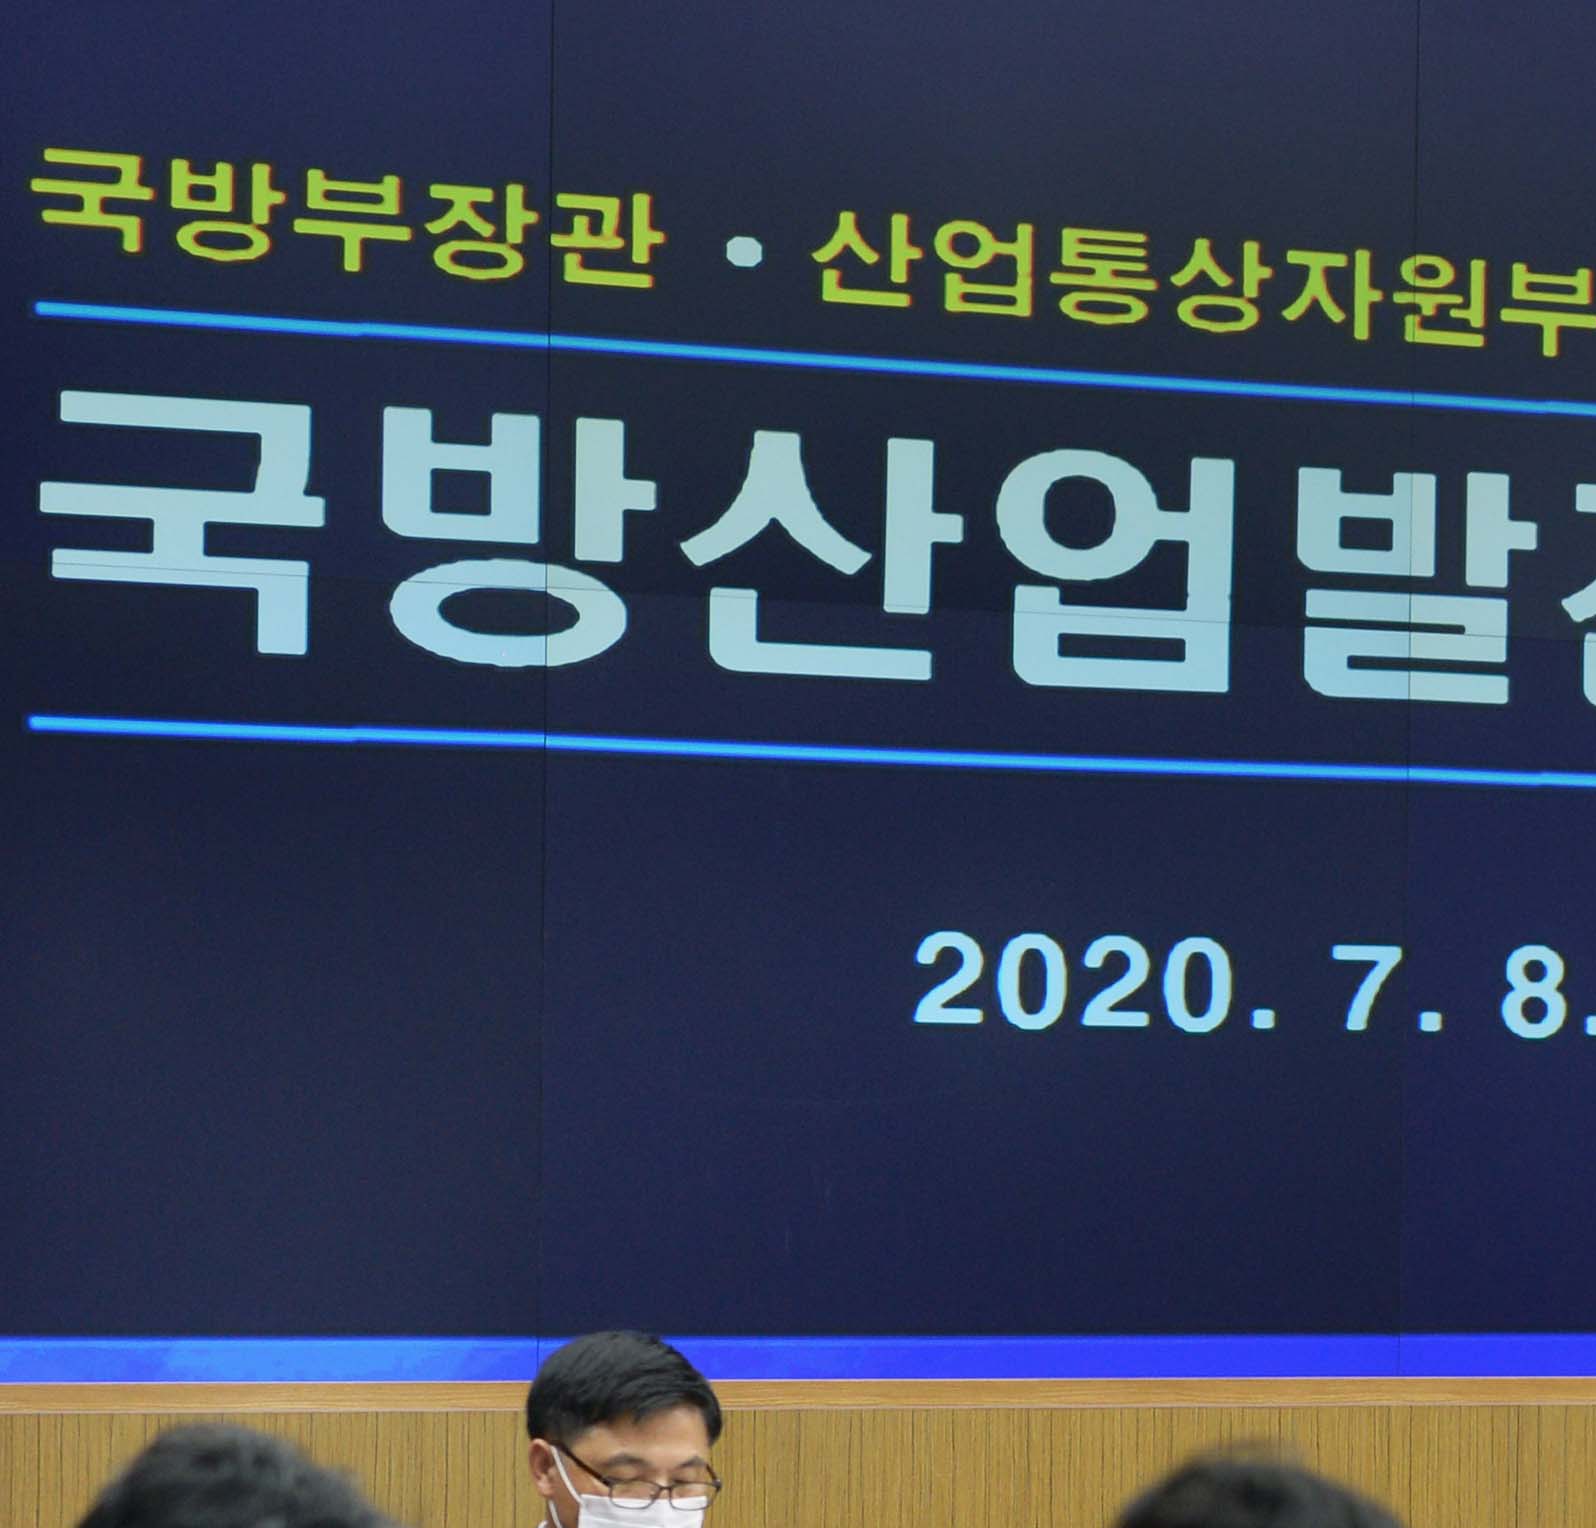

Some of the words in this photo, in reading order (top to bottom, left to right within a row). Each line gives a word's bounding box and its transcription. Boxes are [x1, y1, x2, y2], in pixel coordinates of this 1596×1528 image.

[31, 148, 665, 289] 국방부장관
[912, 930, 1275, 1033] 2020.
[1331, 943, 1442, 1033] 7.
